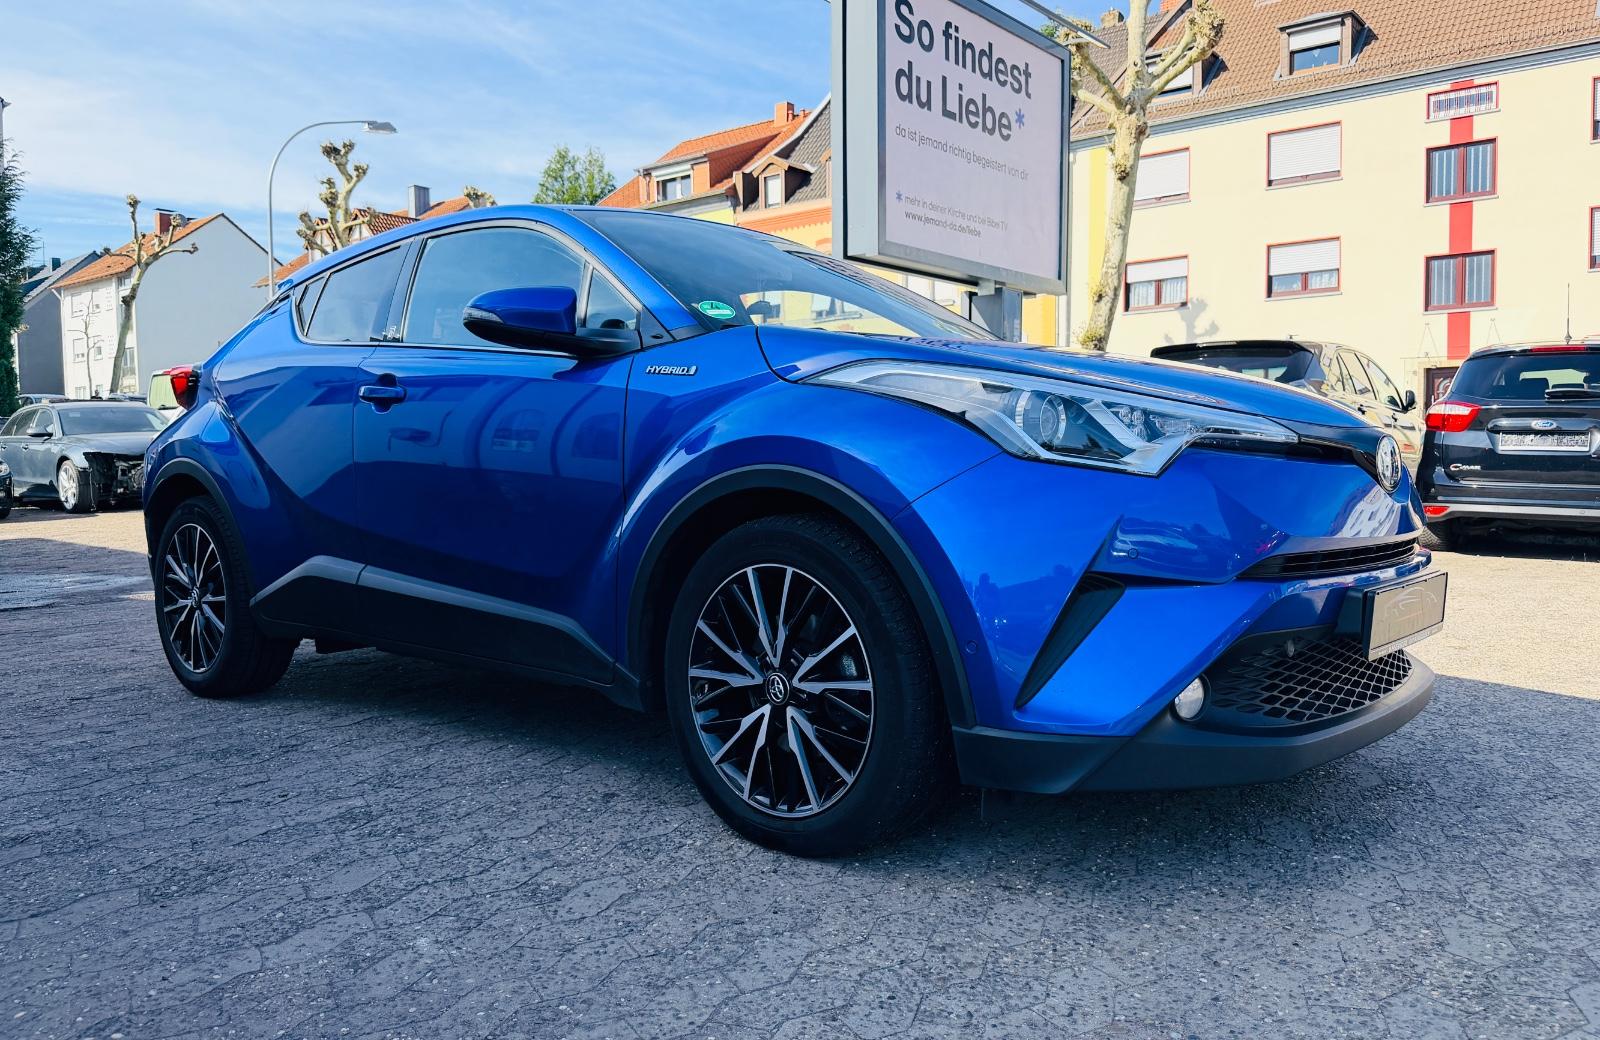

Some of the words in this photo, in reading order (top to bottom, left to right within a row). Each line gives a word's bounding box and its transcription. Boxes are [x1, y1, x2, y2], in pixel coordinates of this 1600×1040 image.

[894, 0, 934, 53] So
[942, 21, 1032, 99] findest
[895, 60, 932, 112] du
[895, 124, 906, 138] da
[907, 128, 917, 142] ist
[918, 131, 948, 153] jemand
[949, 143, 972, 164] richtig
[972, 151, 1007, 174] begeistert
[1008, 166, 1020, 179] von
[904, 195, 921, 208] mehr
[922, 199, 928, 209] in
[928, 200, 947, 214] deiner
[947, 207, 966, 220] Kirche
[966, 213, 978, 223] und
[1000, 220, 1009, 232] TV
[645, 365, 688, 375] HYBRID
